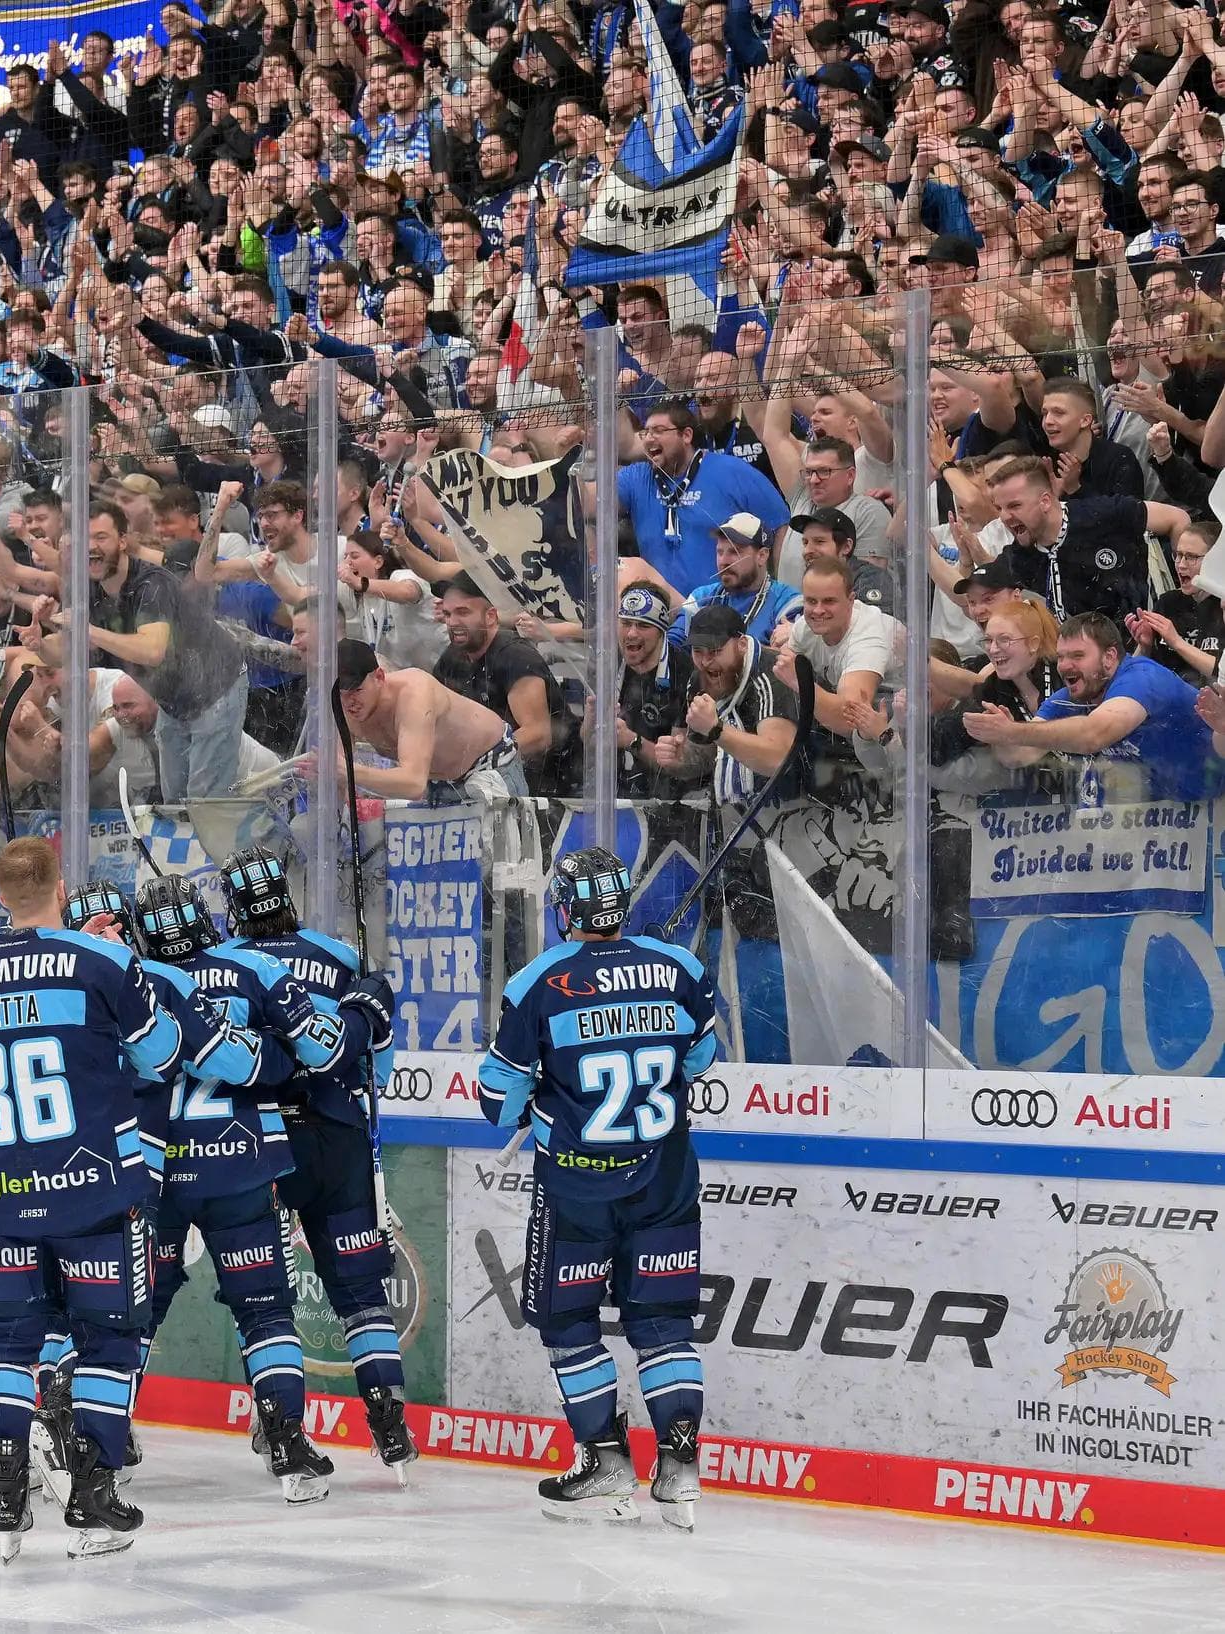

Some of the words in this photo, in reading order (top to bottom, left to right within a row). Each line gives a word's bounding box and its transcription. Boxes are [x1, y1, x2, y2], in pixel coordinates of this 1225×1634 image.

[605, 186, 723, 230] ULTRAS
[991, 843, 1094, 883] Divided
[1102, 852, 1134, 872] we
[596, 963, 678, 992] SATURN
[577, 1004, 676, 1040] EDWARDS
[578, 1045, 677, 1143] 23
[744, 1083, 830, 1116] Audi
[1075, 1094, 1171, 1130] Audi
[221, 1245, 274, 1269] CINQUE
[335, 1229, 383, 1251] CINQUE
[130, 1217, 147, 1307] SATURN
[638, 1250, 698, 1272] CINQUE
[1044, 1298, 1184, 1353] Fairplay
[1075, 1350, 1122, 1367] Hockey
[1126, 1352, 1159, 1374] Shop
[1017, 1400, 1052, 1422] IHR
[1057, 1403, 1213, 1437] FACHHÄNDLER
[1035, 1432, 1055, 1453] IN
[1061, 1434, 1194, 1467] INGOLSTADT
